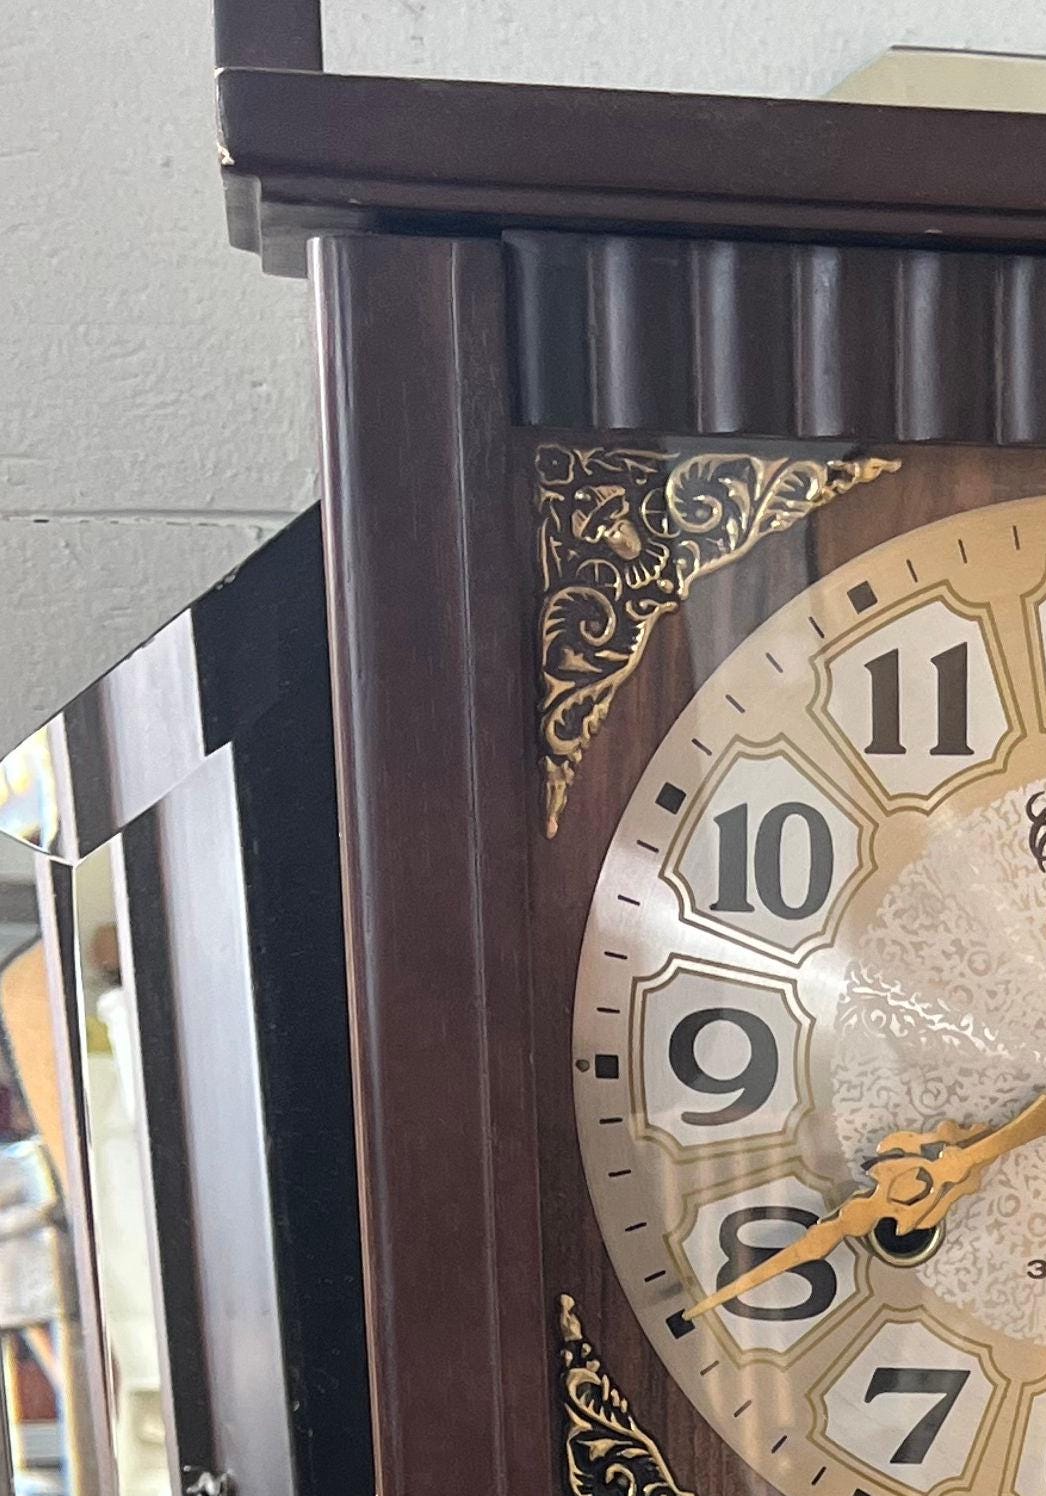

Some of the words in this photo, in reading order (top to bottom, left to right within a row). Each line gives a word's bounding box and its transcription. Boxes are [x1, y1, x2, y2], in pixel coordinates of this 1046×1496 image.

[864, 642, 975, 755] 11
[710, 802, 834, 920] 10
[668, 1008, 779, 1126] 9
[716, 1206, 837, 1321] 8
[864, 1367, 971, 1464] 7
